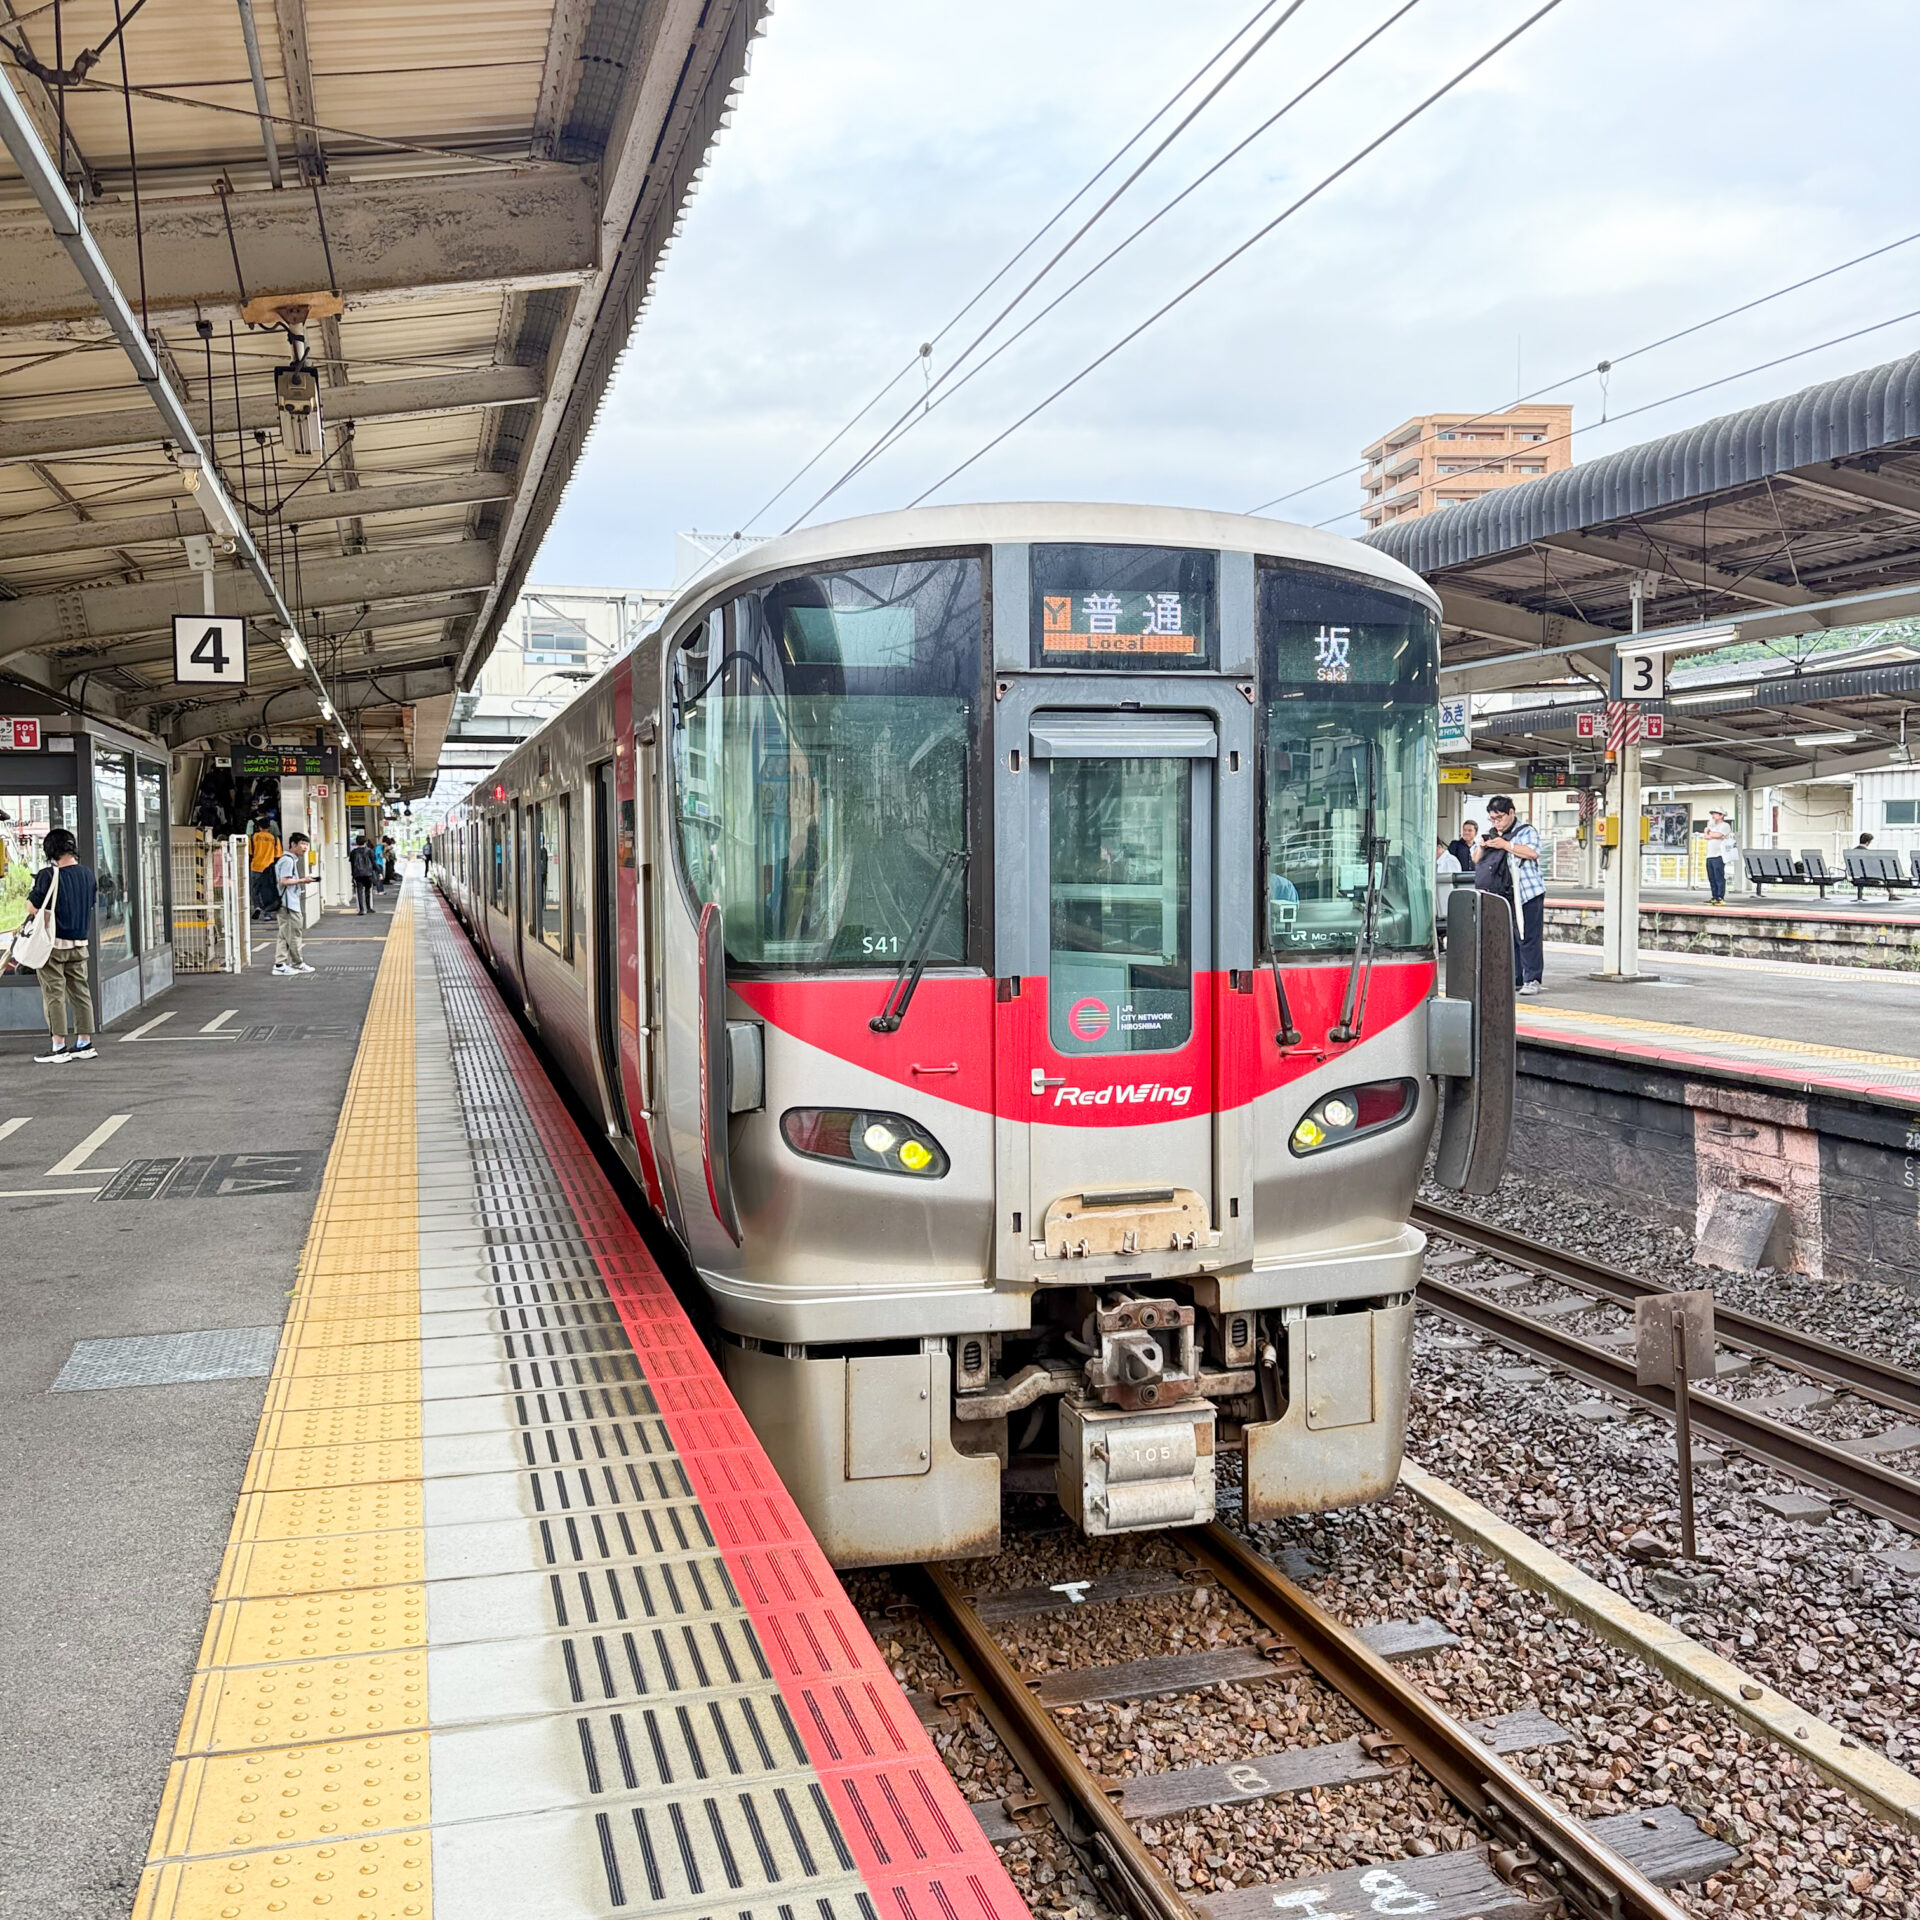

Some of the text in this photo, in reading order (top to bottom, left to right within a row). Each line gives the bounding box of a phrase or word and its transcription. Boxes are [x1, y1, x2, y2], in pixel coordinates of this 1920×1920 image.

[1082, 592, 1183, 635] 普通
[190, 626, 230, 673] 4
[1086, 637, 1145, 651] Local
[1314, 625, 1351, 668] 坂
[1316, 668, 1348, 682] Saka
[1633, 657, 1654, 691] 3
[326, 747, 333, 755] 4
[1291, 930, 1307, 941] JR
[862, 936, 899, 953] S41
[1121, 1022, 1161, 1030] HIROSHIMA
[1135, 1447, 1170, 1462] 105
